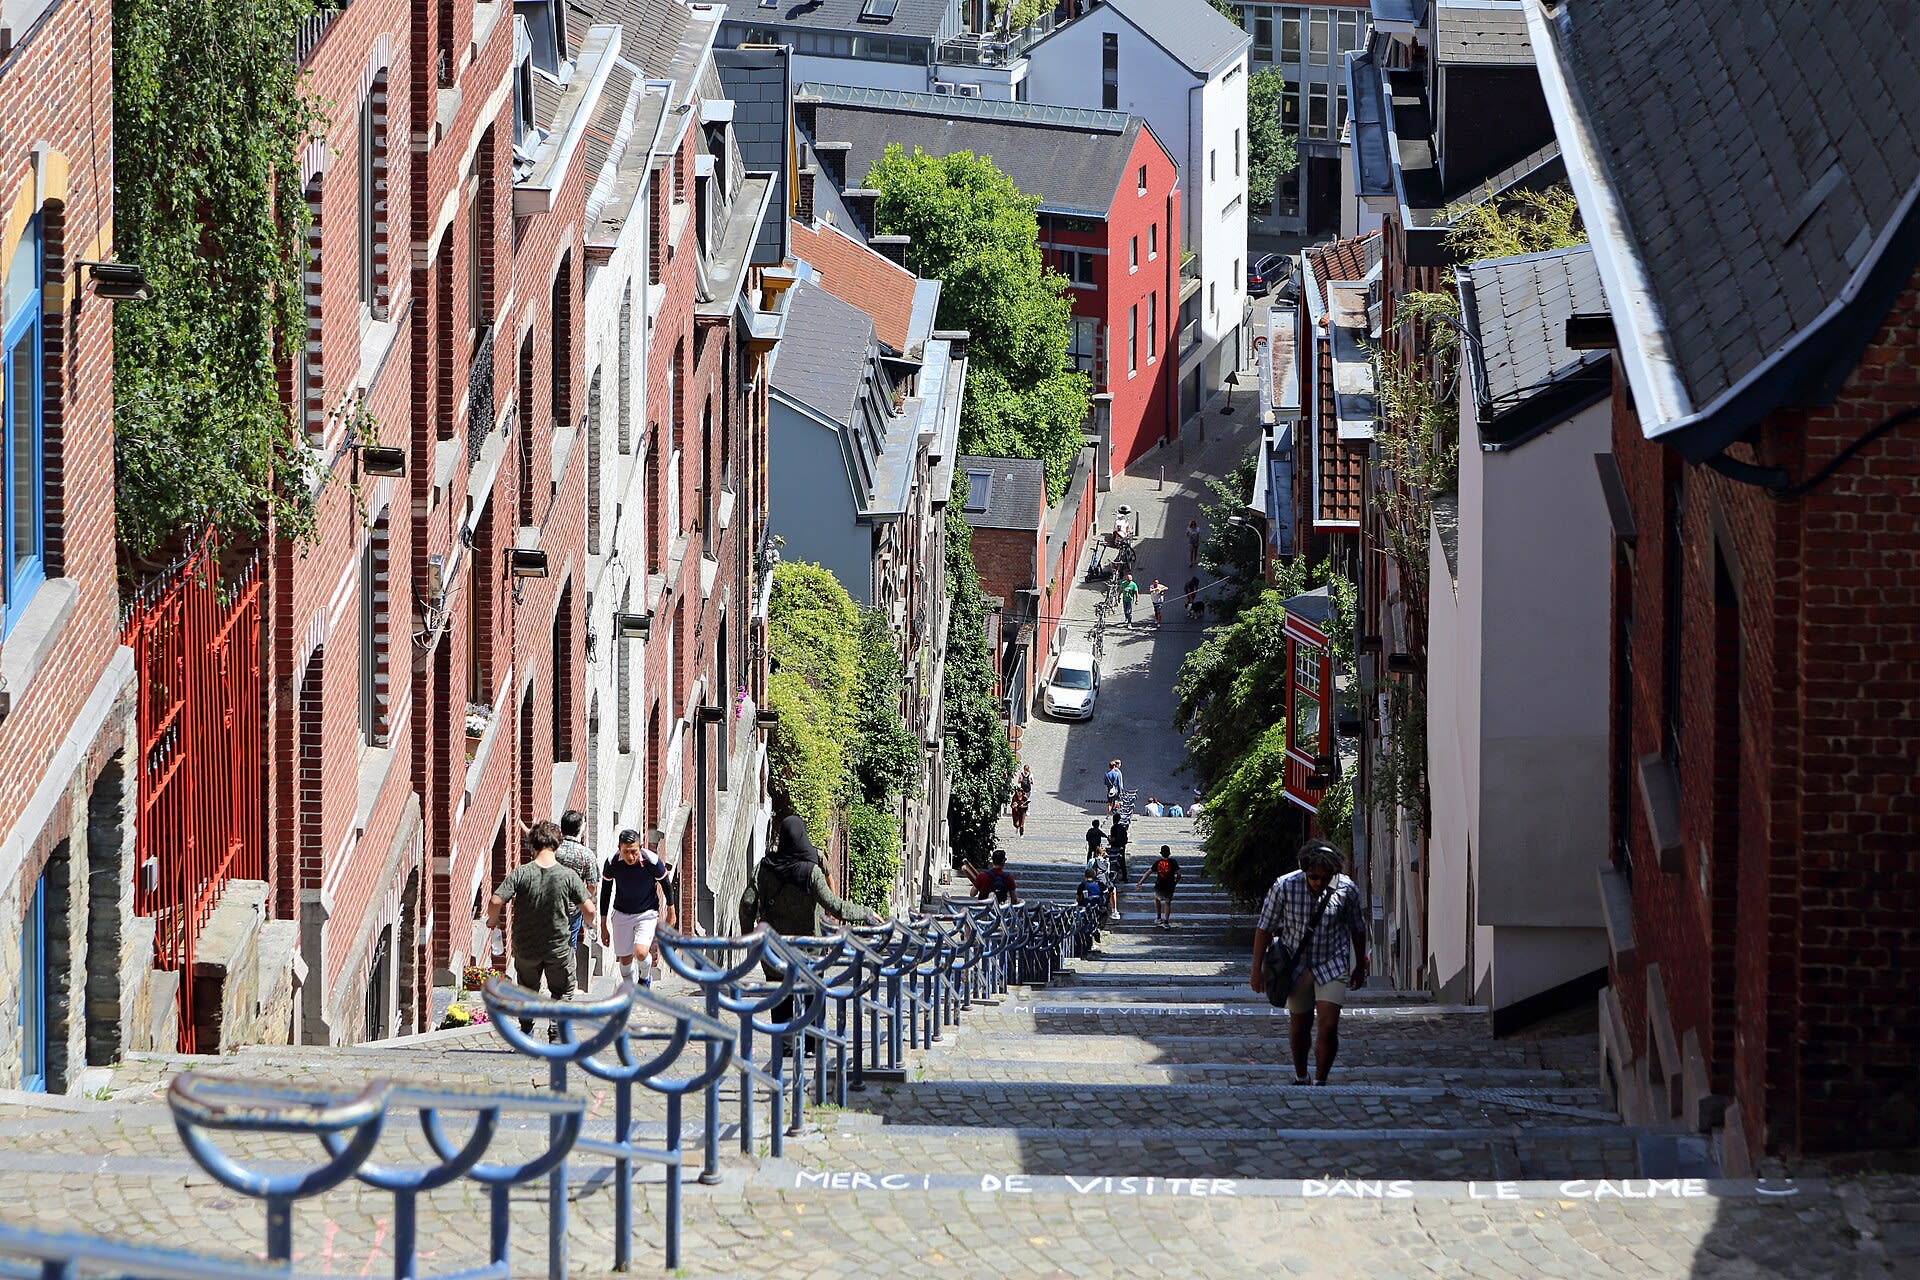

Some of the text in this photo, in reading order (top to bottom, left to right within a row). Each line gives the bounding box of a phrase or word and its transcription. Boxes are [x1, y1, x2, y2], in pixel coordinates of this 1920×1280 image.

[1014, 1006, 1068, 1014] MERCI
[1083, 1007, 1105, 1015] DE
[1118, 1007, 1190, 1015] VISITER
[1204, 1008, 1254, 1016] DANS
[795, 1171, 1708, 1201] MERCI DE VISITER DANS LE CALME
